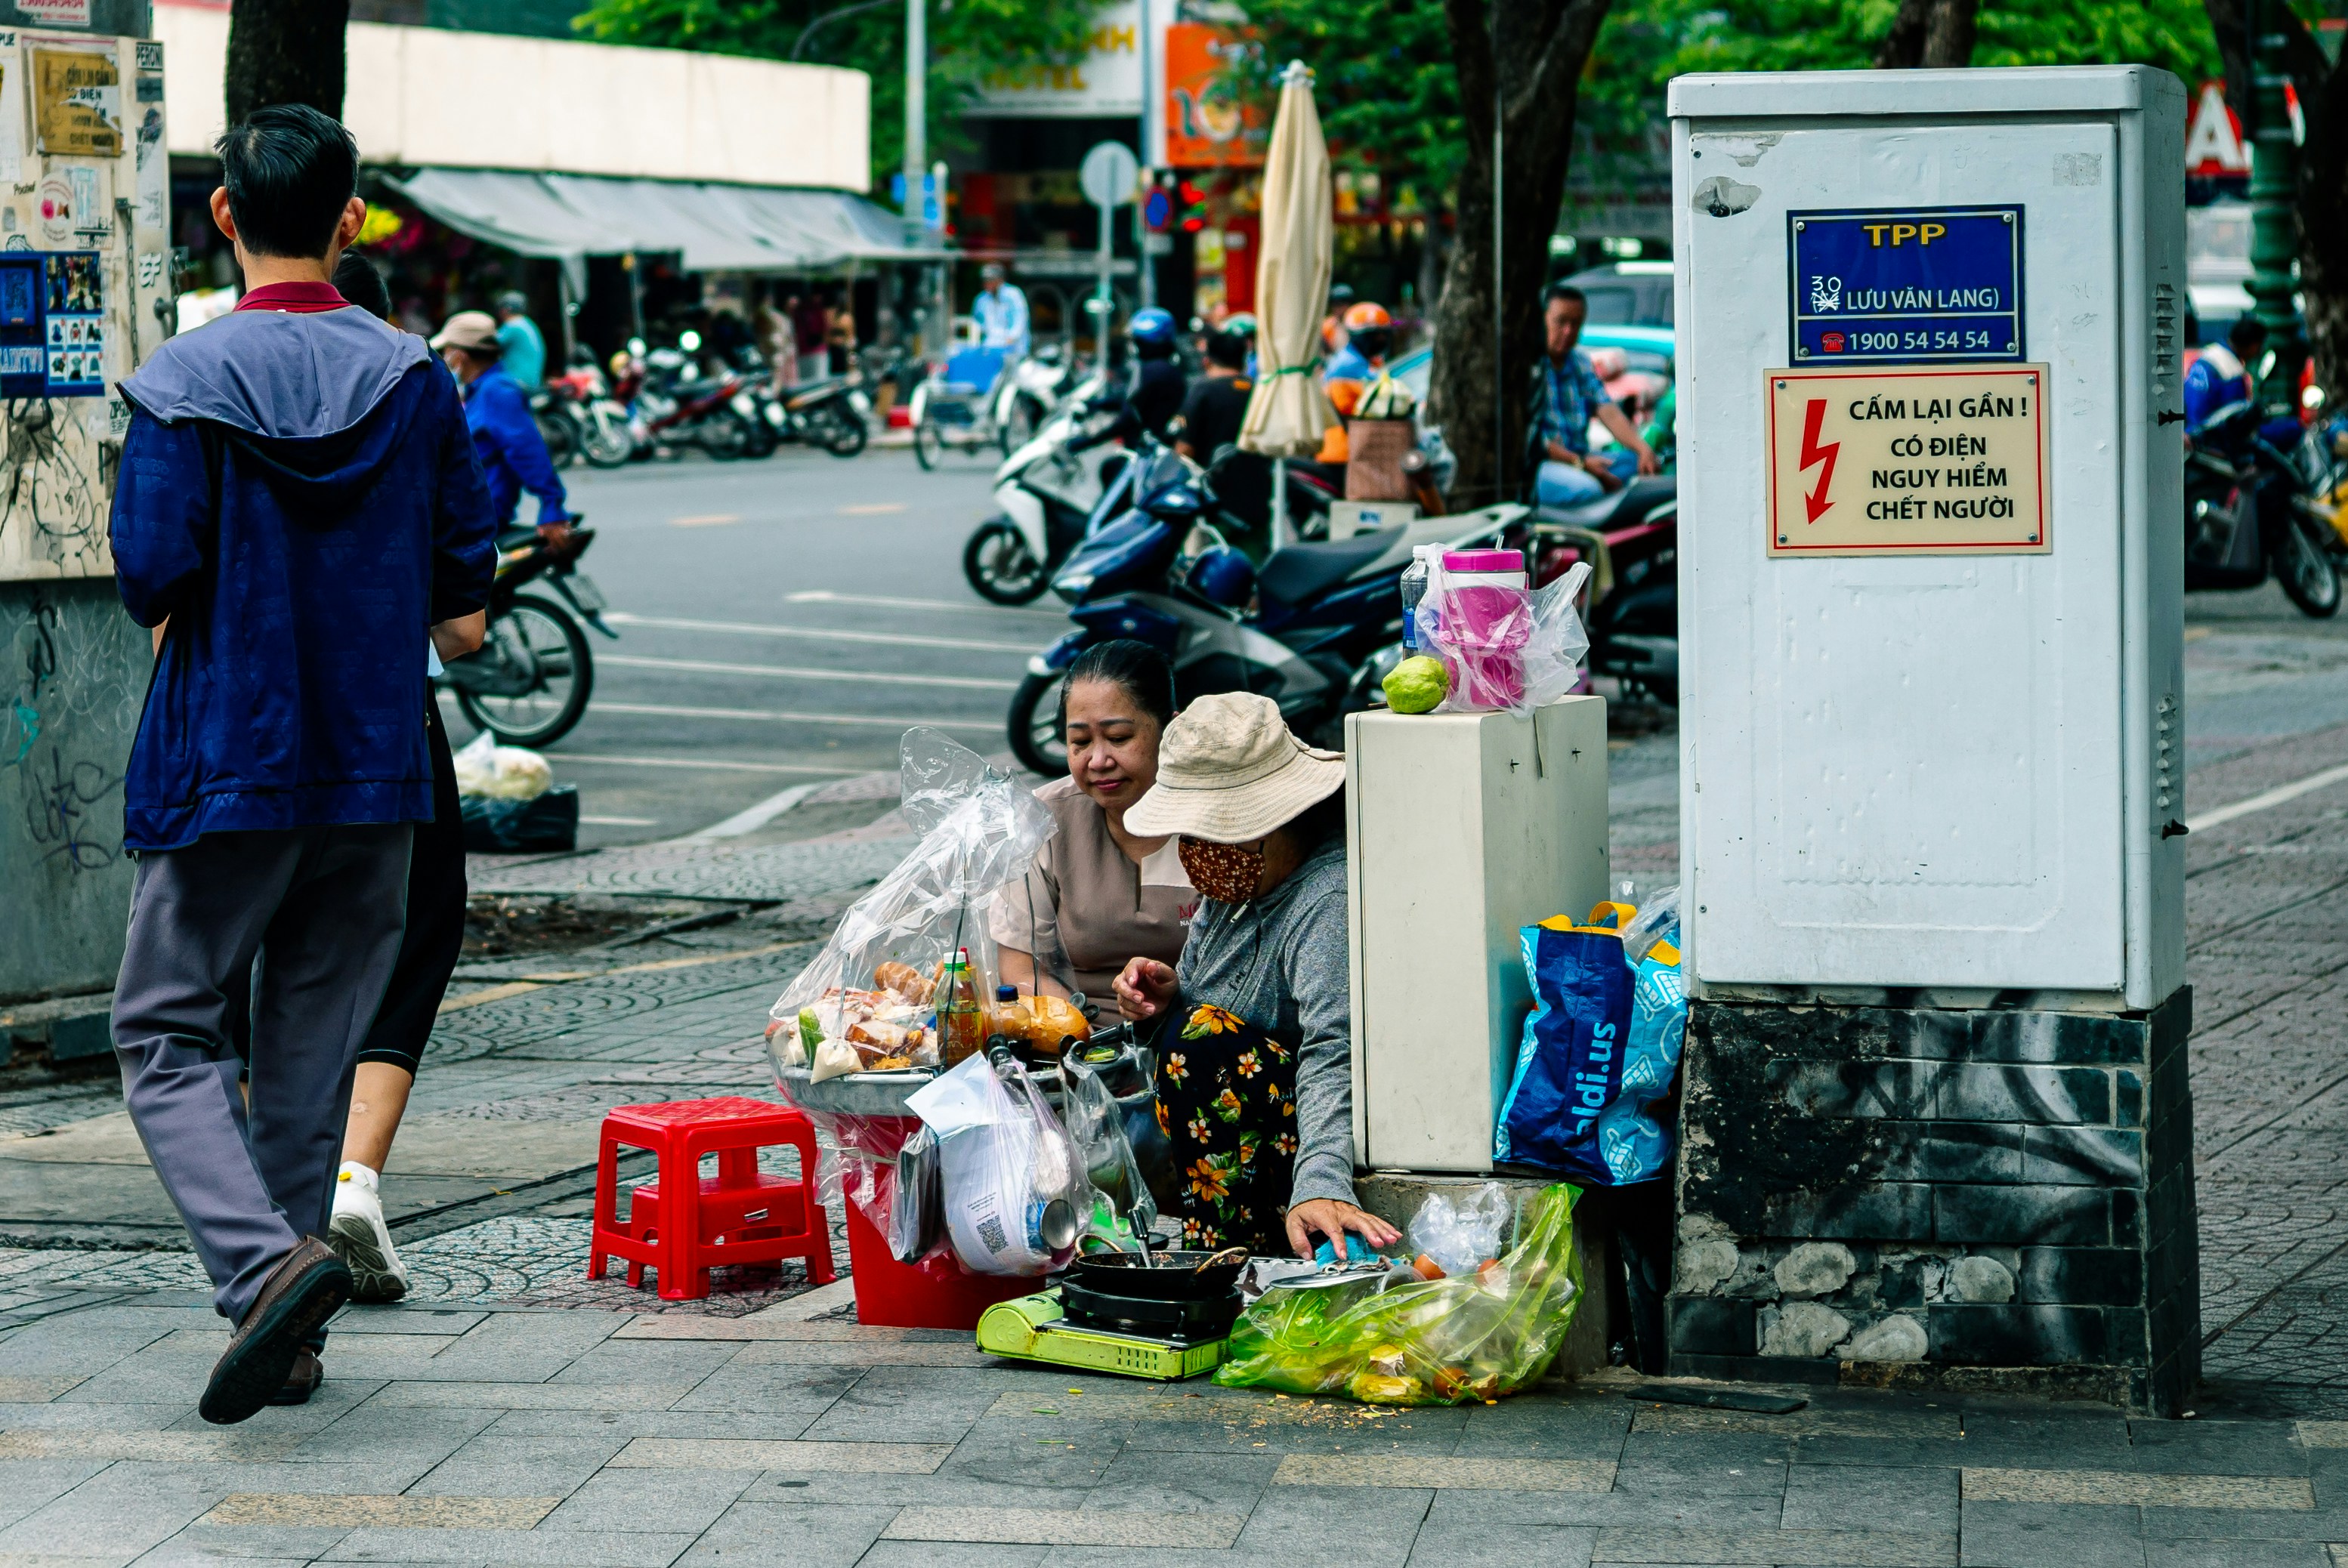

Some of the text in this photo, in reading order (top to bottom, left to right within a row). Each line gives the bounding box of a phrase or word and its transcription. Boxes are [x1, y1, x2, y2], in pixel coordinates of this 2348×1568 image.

[1864, 224, 1945, 246] TPP
[1847, 288, 1886, 310] LƯU
[1891, 286, 1932, 309] VĂN
[1938, 288, 1999, 310] LANG)
[1849, 331, 1990, 350] 1900 54 54 54
[1849, 394, 1905, 421] CẤM
[1913, 398, 1951, 424] LẠI
[1958, 391, 2014, 418] GẦN
[1890, 433, 1986, 461] CÓ ĐIỆN
[1872, 460, 2007, 489] NGUY HIỂM
[1866, 494, 2014, 520] CHẾT NGƯỜI
